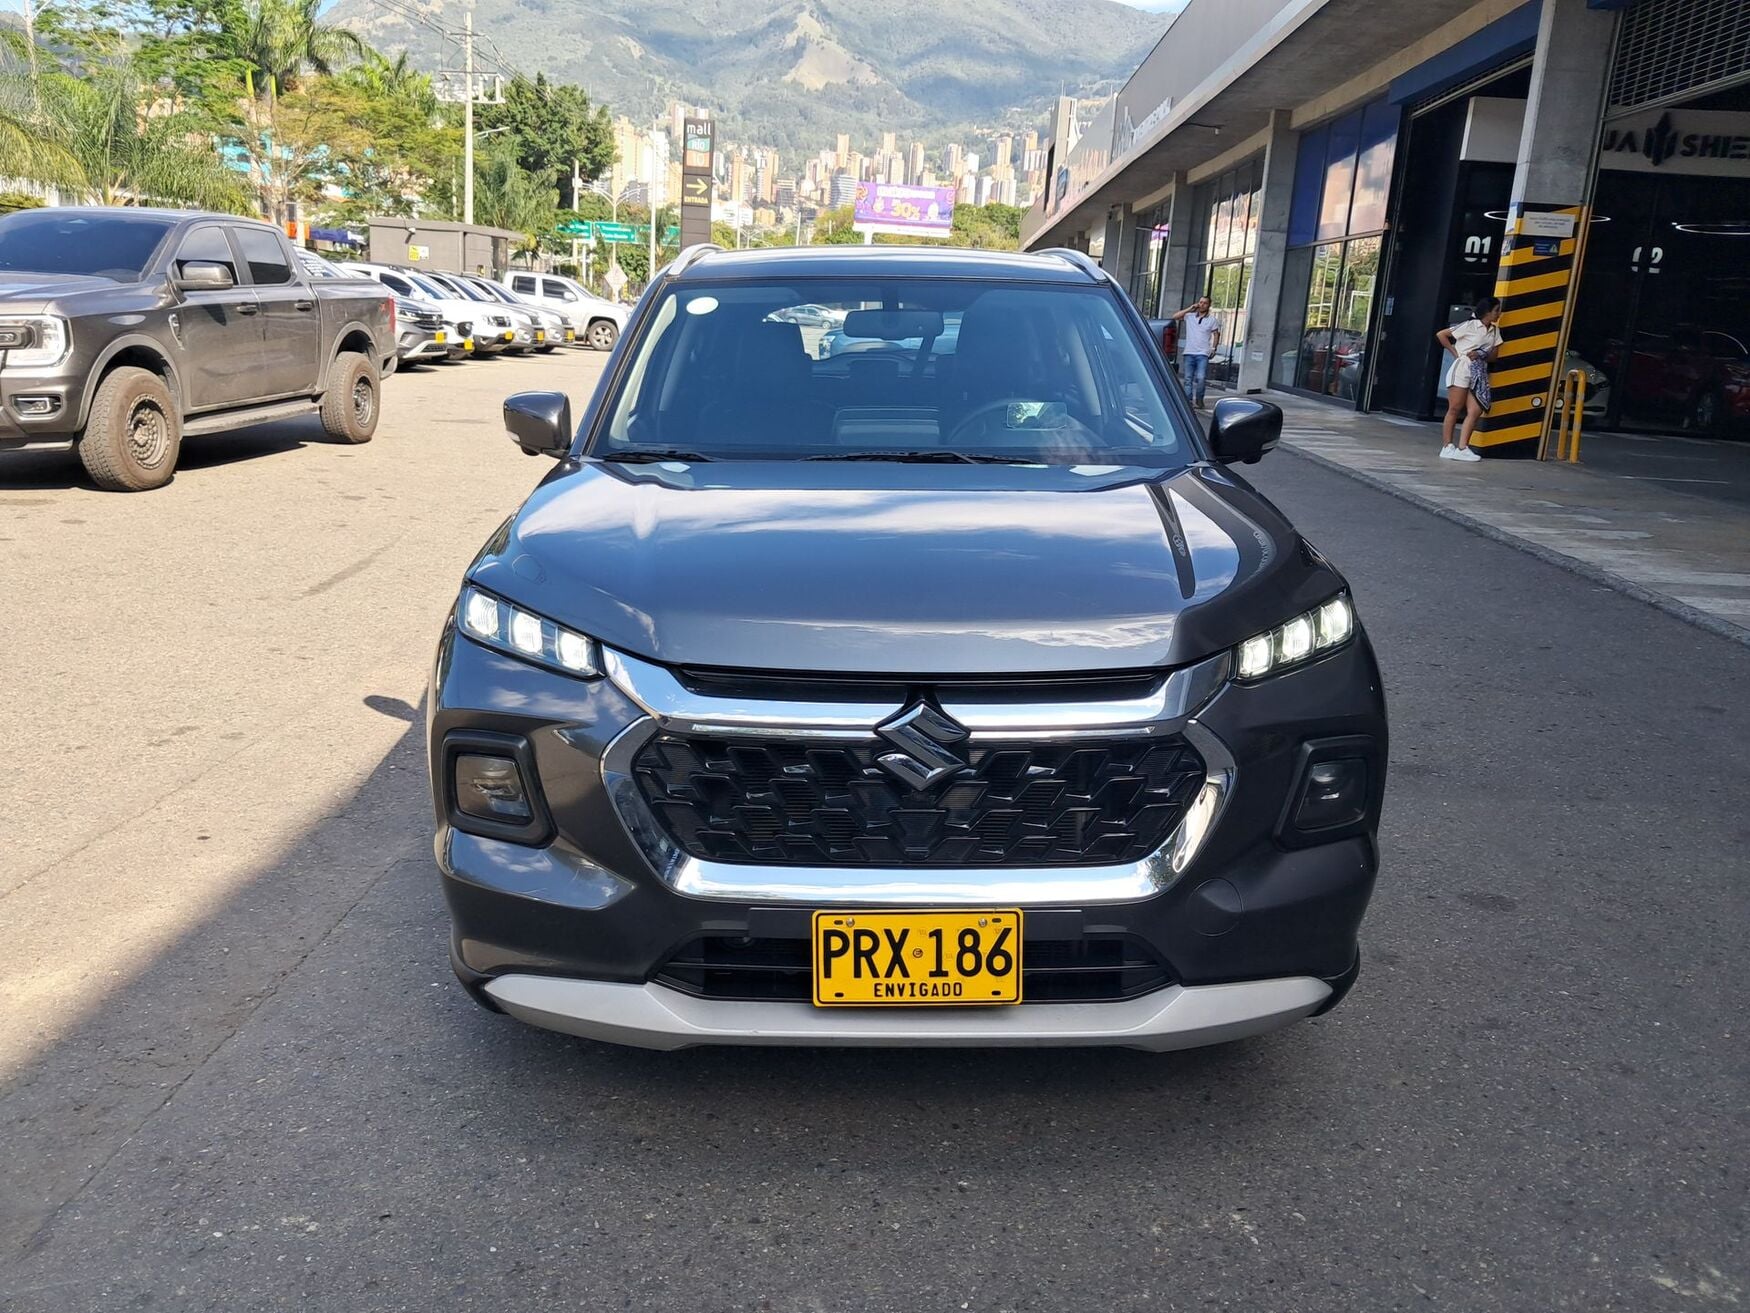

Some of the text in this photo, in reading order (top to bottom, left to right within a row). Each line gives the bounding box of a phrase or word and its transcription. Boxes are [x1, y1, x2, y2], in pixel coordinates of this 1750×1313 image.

[687, 122, 712, 135] mall
[1464, 235, 1492, 263] 01
[823, 928, 1013, 979] PRX 186
[874, 982, 963, 997] ENVIGADO
